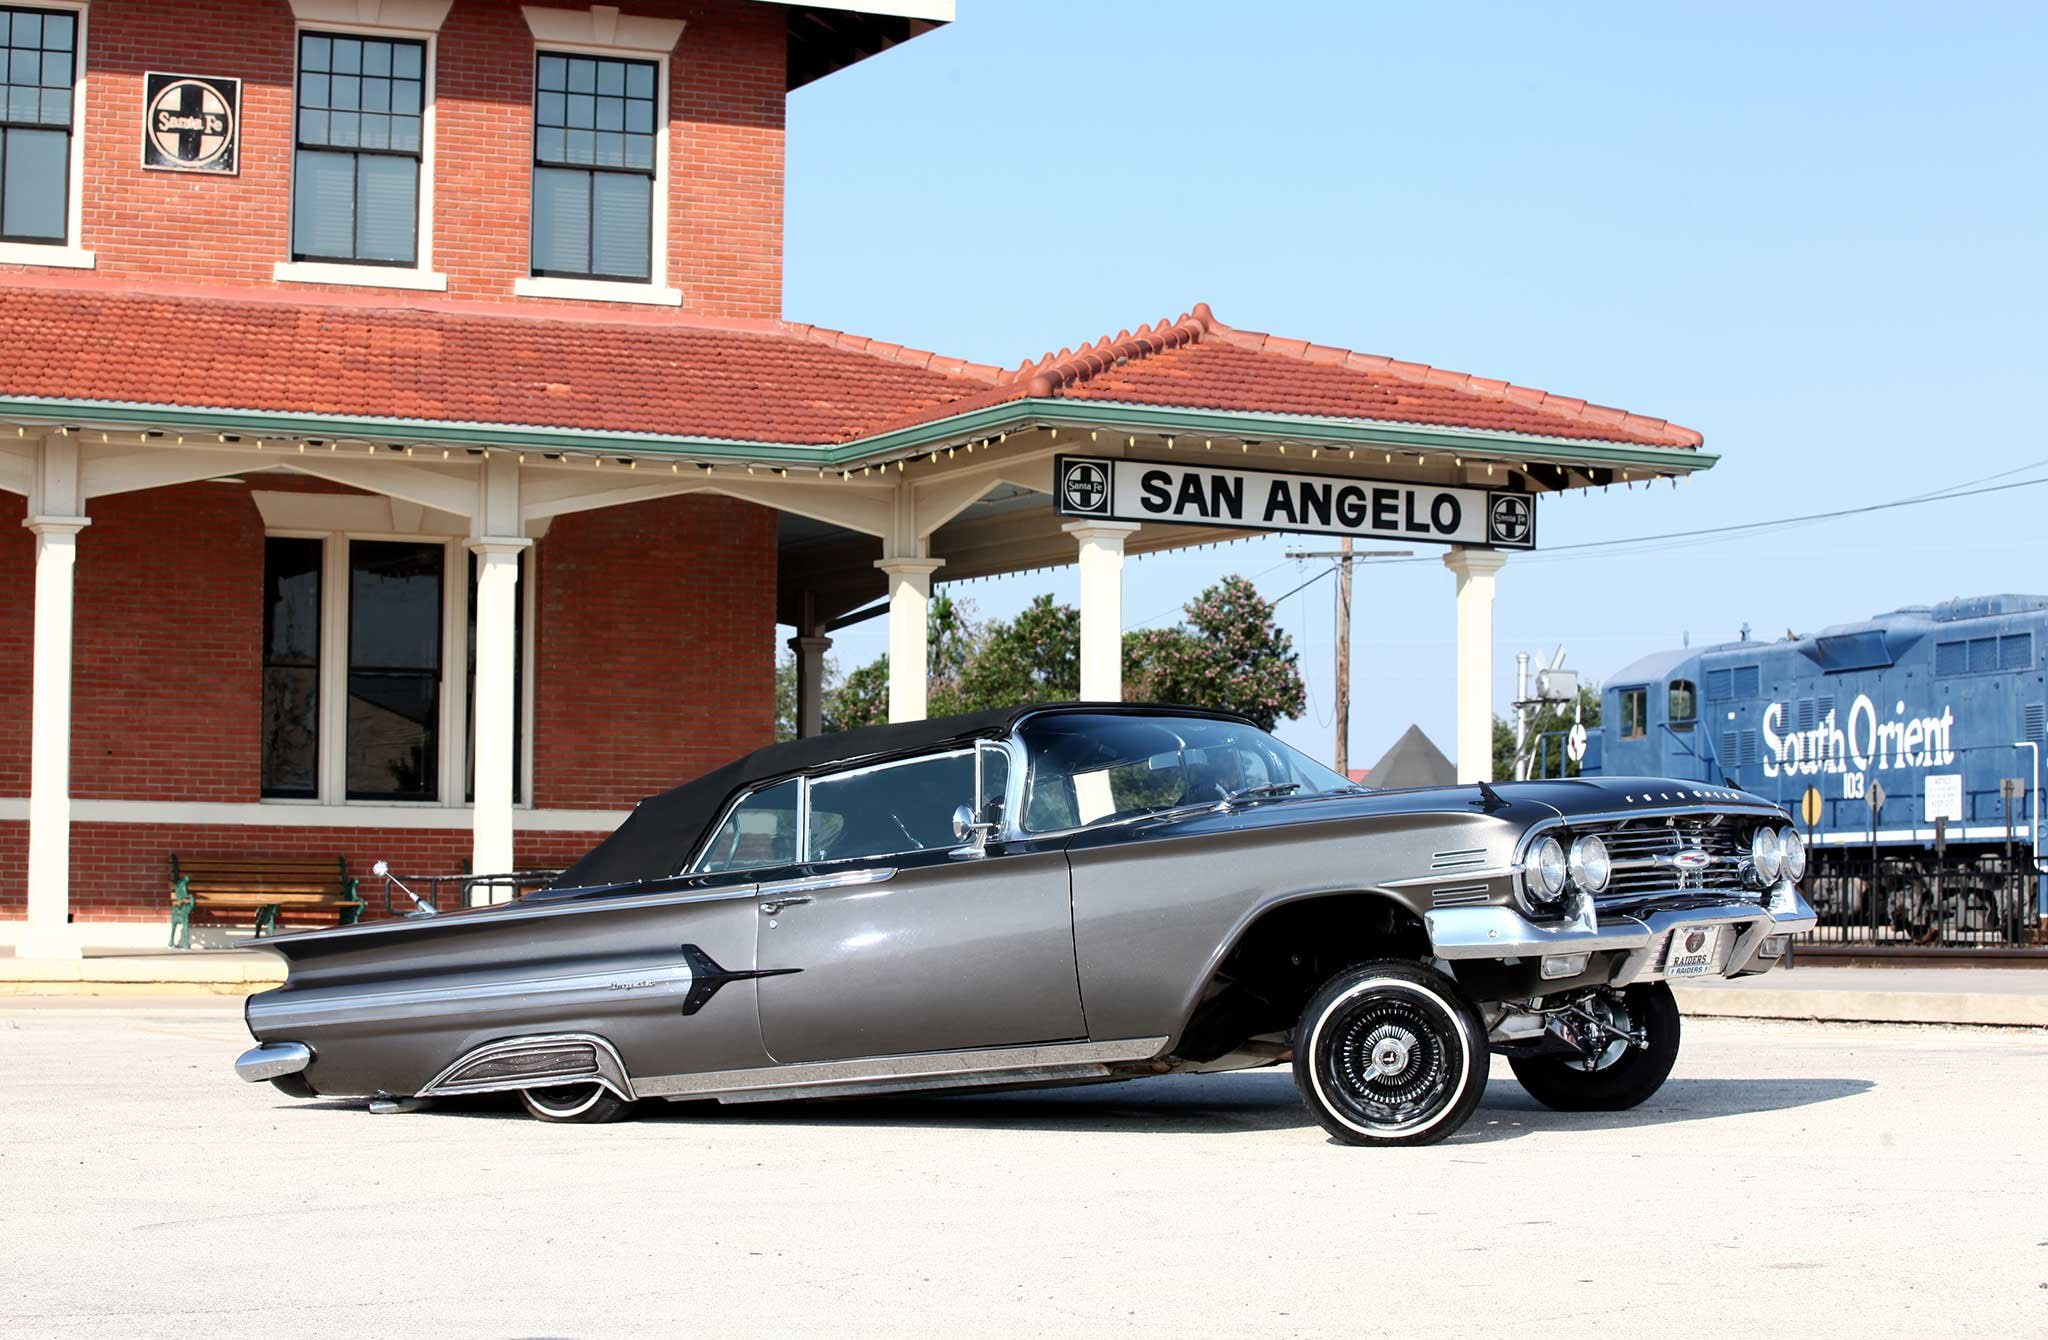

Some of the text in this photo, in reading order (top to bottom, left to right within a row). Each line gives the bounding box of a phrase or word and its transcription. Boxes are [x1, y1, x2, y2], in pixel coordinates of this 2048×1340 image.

[158, 111, 223, 134] Santa Fe
[1068, 480, 1103, 493] Santa Fe
[1140, 469, 1462, 535] SAN ANGELO
[1762, 694, 1955, 777] South Orient
[1843, 772, 1865, 800] 103
[1673, 954, 1708, 967] RAIDERS
[1676, 966, 1703, 975] RAIDERS
